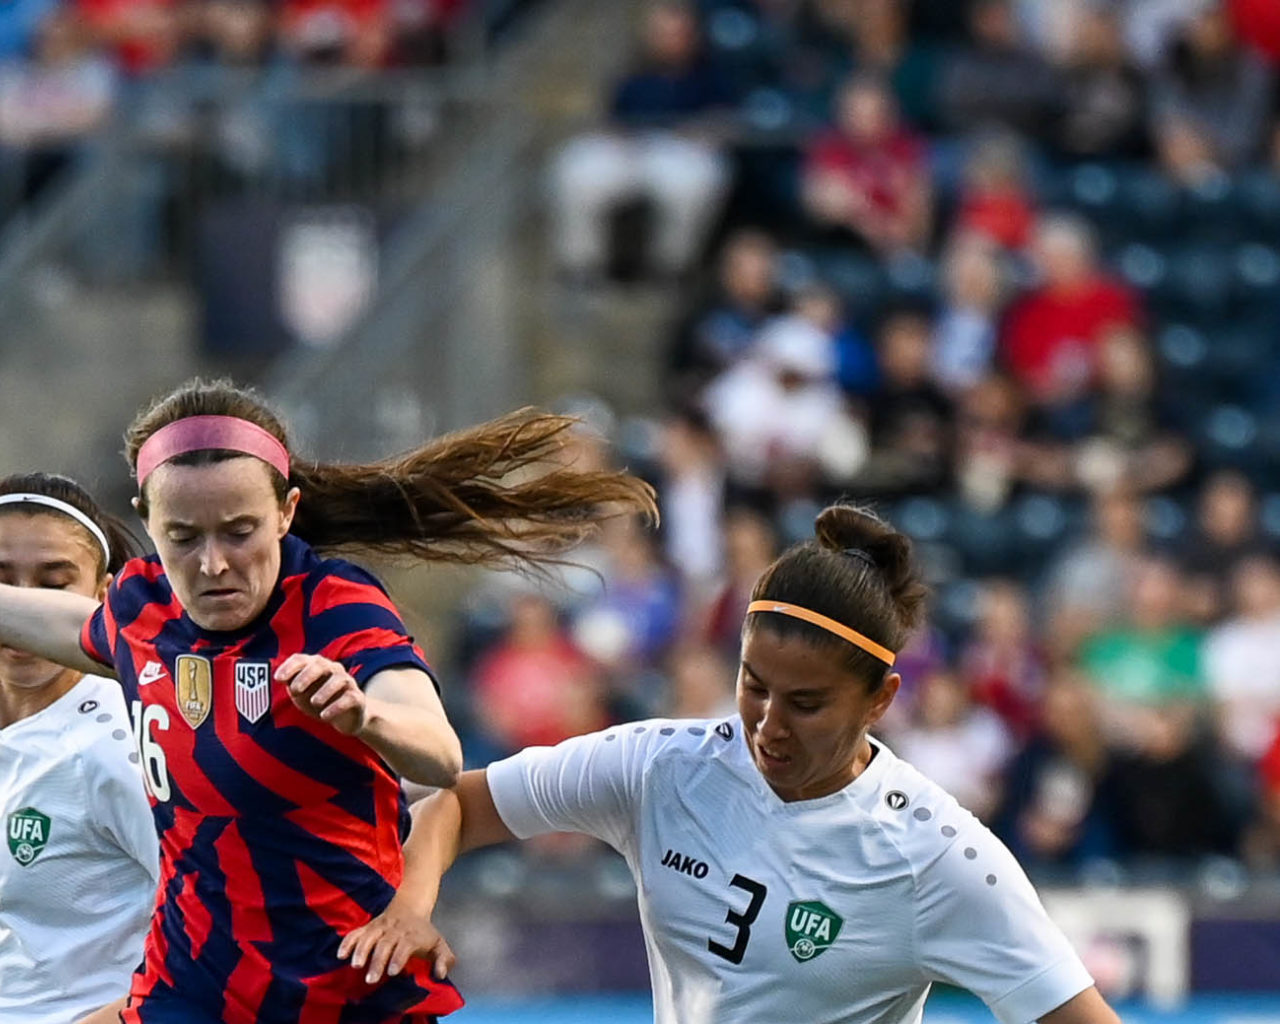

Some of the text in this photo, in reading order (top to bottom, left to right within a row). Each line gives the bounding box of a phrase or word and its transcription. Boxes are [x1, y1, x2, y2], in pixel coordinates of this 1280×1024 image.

[237, 666, 266, 689] USA
[10, 818, 44, 843] UFA
[661, 850, 709, 879] JAKO
[708, 873, 768, 965] 3
[790, 907, 832, 941] UFA
